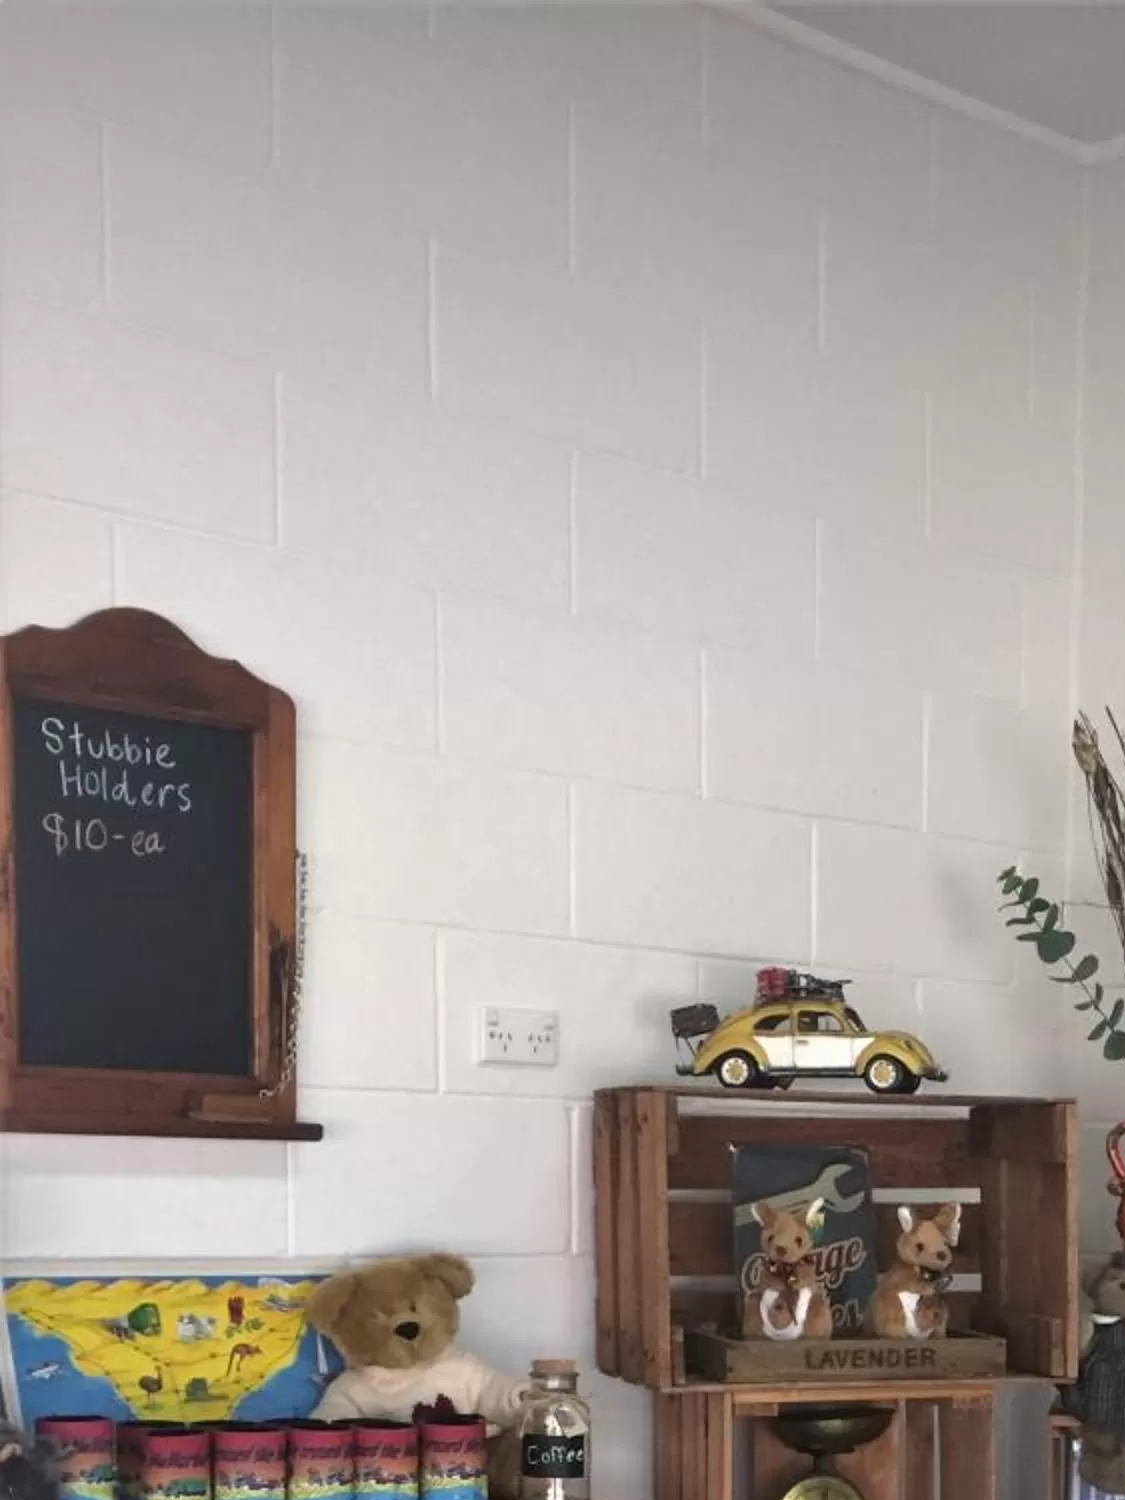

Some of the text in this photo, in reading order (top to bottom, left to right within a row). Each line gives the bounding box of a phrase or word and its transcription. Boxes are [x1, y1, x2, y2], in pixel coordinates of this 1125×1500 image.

[40, 716, 177, 769] Stubbie
[58, 759, 192, 812] Holders
[804, 1347, 937, 1371] LAVENDER
[526, 1445, 584, 1466] Coffee
